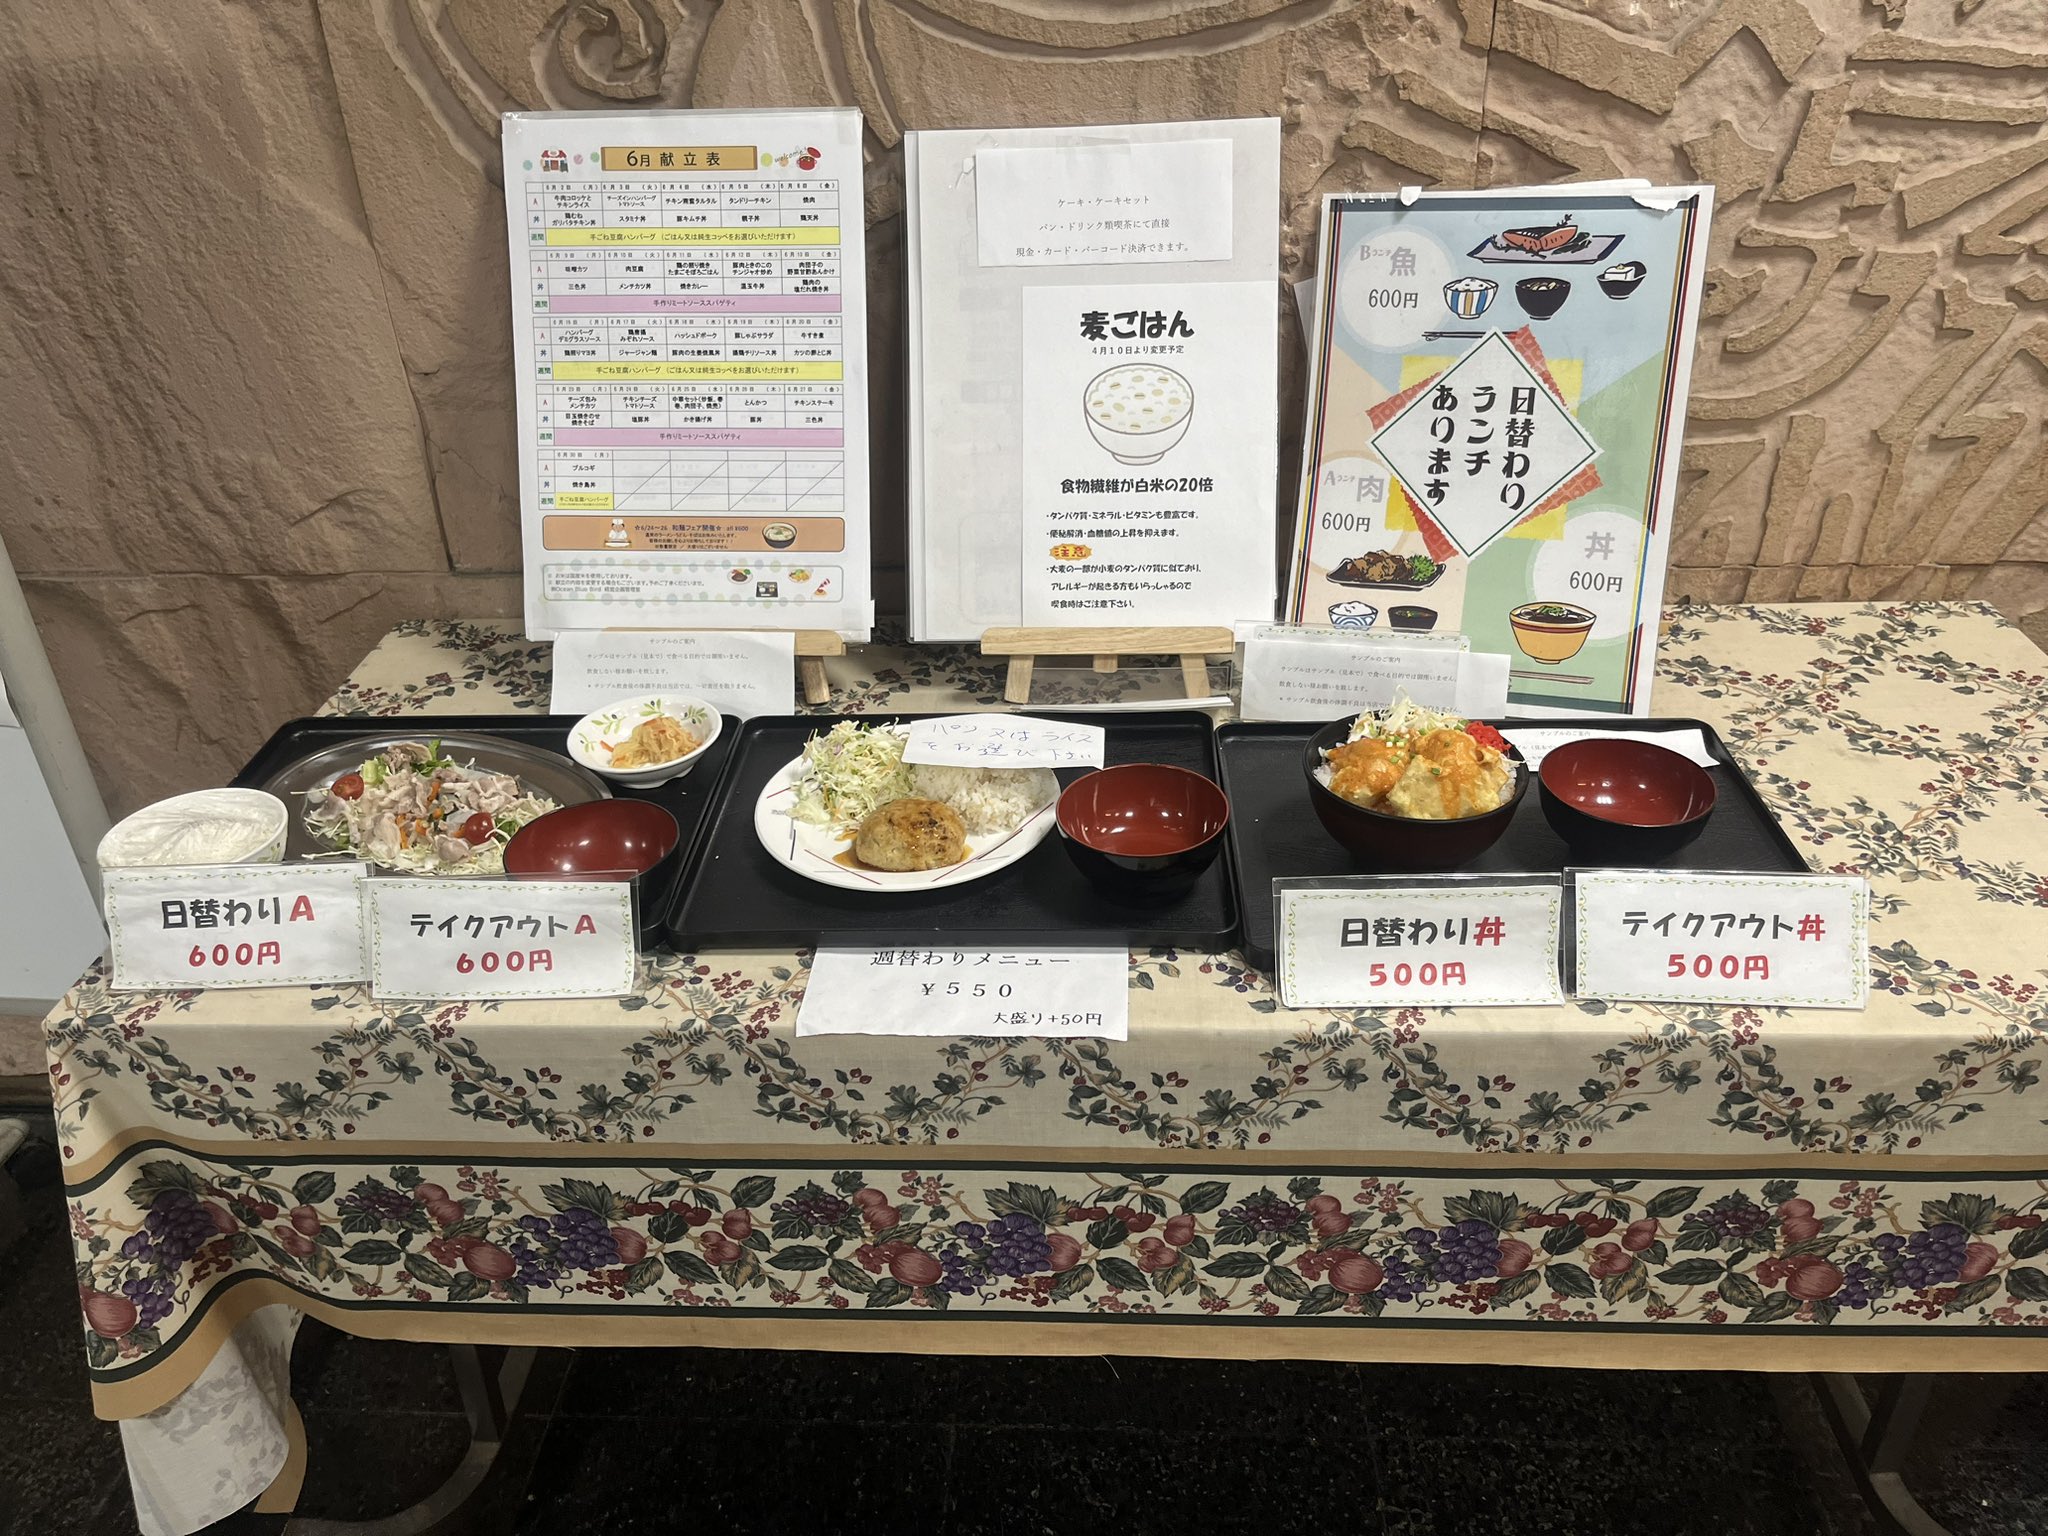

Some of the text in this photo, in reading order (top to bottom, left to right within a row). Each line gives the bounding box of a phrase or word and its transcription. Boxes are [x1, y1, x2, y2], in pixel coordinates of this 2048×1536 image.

[1057, 195, 1150, 207] ケーキ・ケーキセット
[1039, 218, 1170, 231] パン・ドリンク類喫茶にて直接
[1016, 243, 1191, 257] 現金・カード・バーコード決済できます。
[1389, 247, 1416, 276] 魚
[680, 282, 708, 290] 焼きカレー
[1368, 289, 1419, 308] 600円
[1080, 311, 1194, 340] 麦ごはん
[1464, 386, 1496, 476] ランチ
[1424, 384, 1458, 506] あります
[1500, 386, 1536, 511] 日替わり
[1061, 478, 1214, 494] 食物繊維が白米の20倍
[1356, 476, 1384, 502] 肉
[1321, 513, 1371, 532] 600円
[1584, 532, 1615, 560] 丼
[1051, 581, 1191, 591] アレルギーが起きる方もいらっしゃるので
[1569, 572, 1623, 592] 600円
[1051, 599, 1135, 609] 喫食時はご注意下さい。
[1351, 654, 1401, 664] サンプルのご案内
[1340, 915, 1506, 947] 日替わり丼
[1622, 910, 1826, 942] テイクアウト丼
[189, 941, 282, 967] 600円
[456, 949, 554, 975] 600円
[870, 950, 1070, 966] 週替わりメニュー
[1667, 953, 1769, 979] 500円
[1368, 962, 1466, 986] 500円
